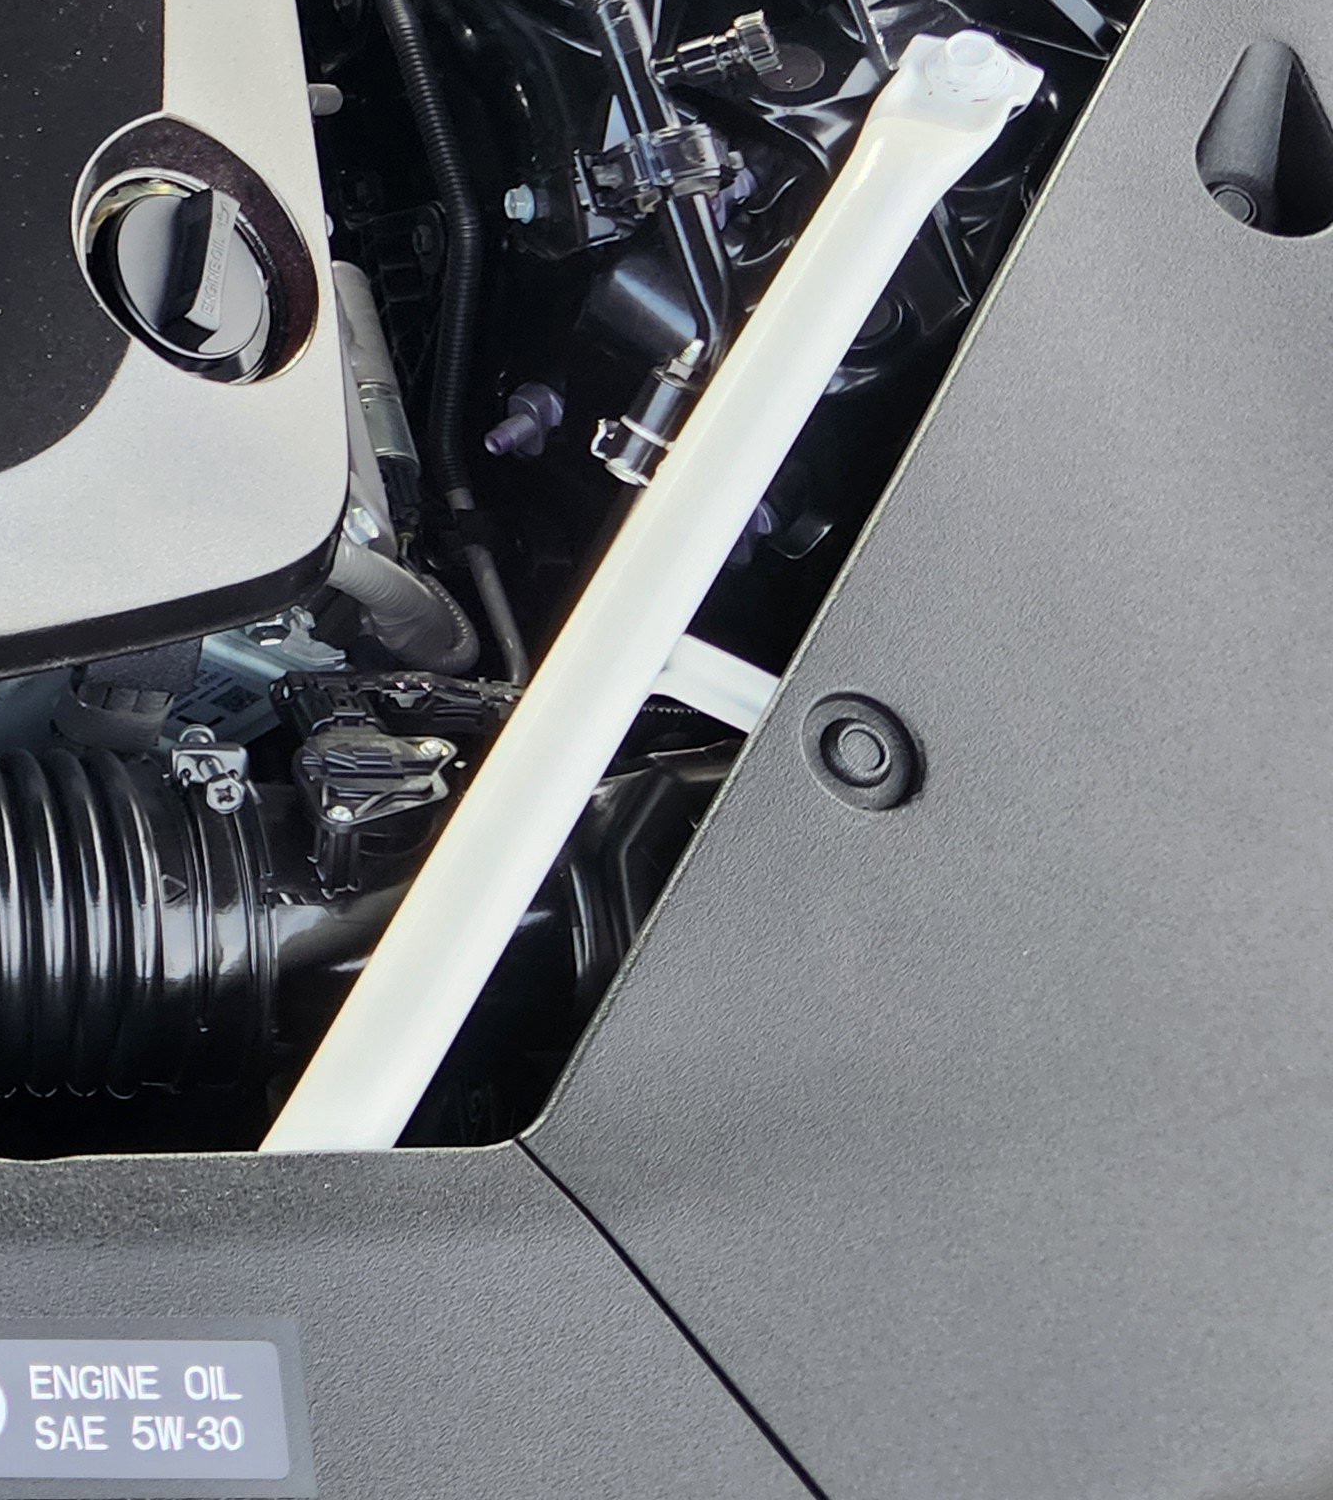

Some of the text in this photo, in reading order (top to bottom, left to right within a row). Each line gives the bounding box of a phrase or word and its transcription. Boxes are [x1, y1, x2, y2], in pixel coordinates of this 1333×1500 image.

[200, 238, 226, 316] ENGINE OIL
[29, 1365, 243, 1401] ENGINE OIL
[35, 1415, 245, 1451] SAE 5W-30
